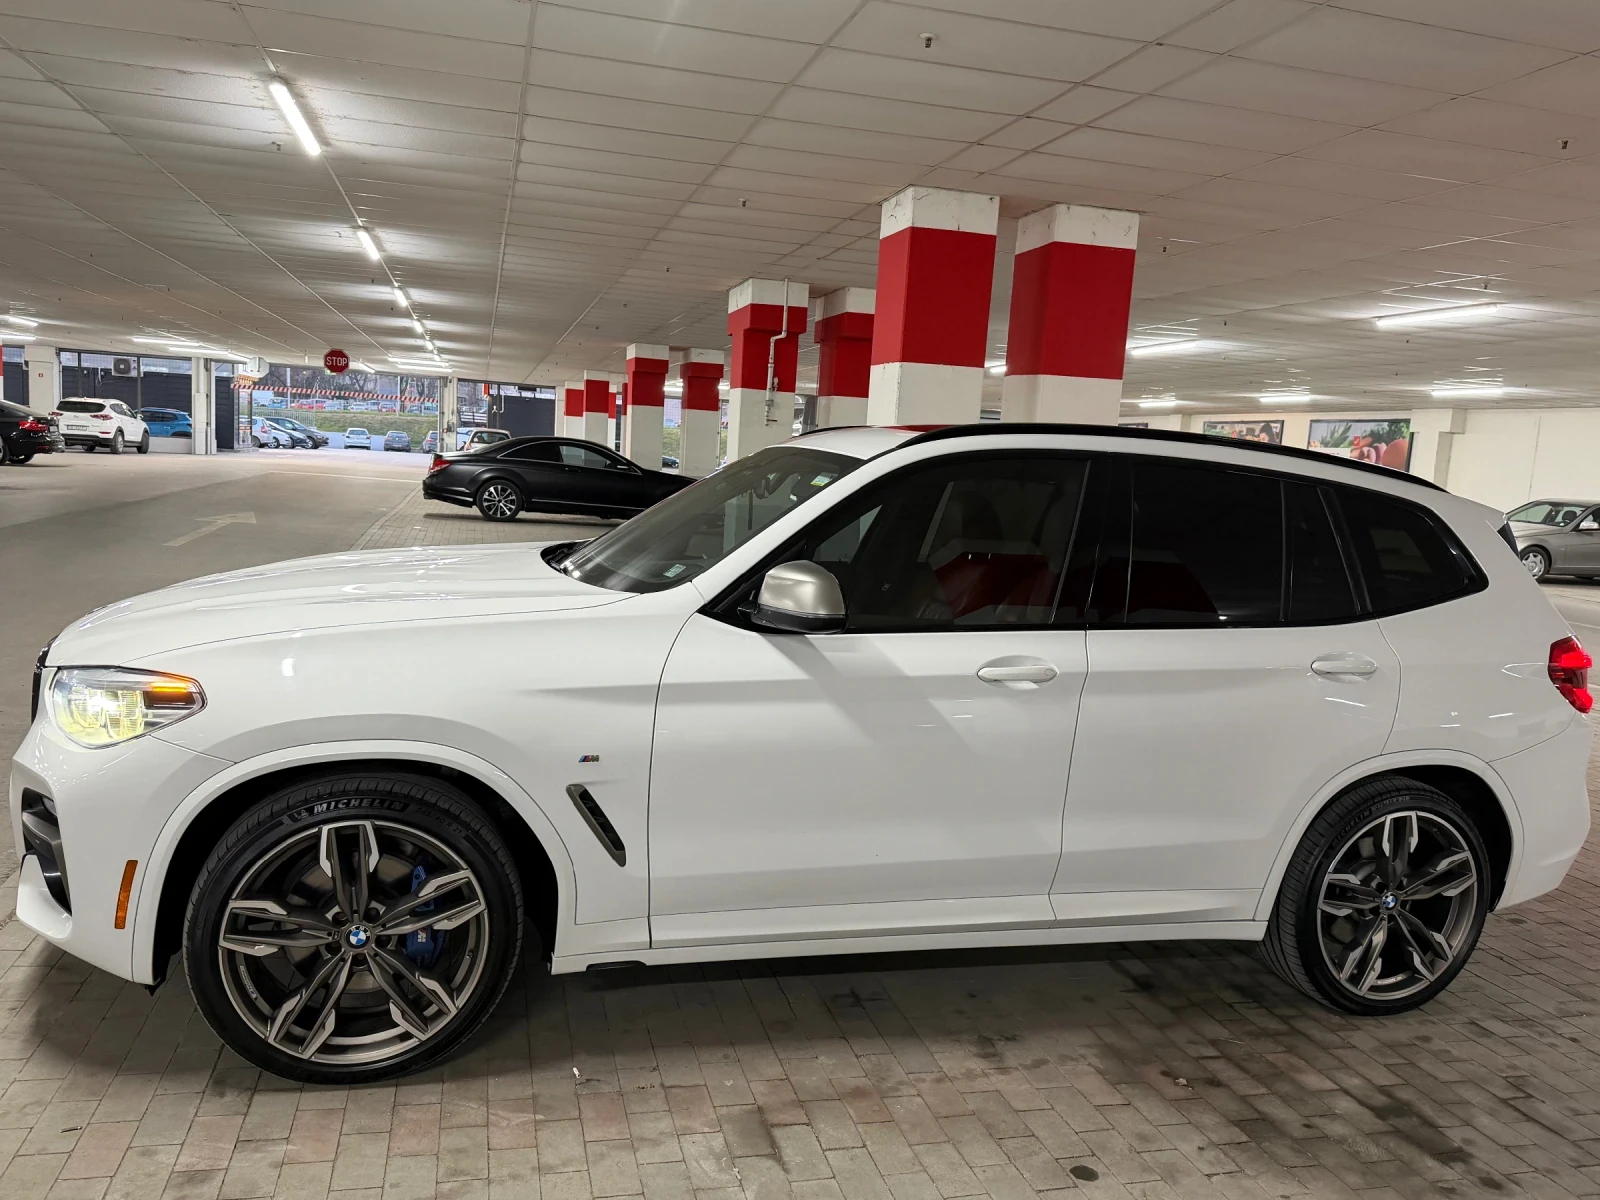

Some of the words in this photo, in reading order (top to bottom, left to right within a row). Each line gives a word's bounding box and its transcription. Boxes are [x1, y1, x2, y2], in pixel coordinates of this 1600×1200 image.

[326, 356, 348, 367] STOP
[313, 798, 405, 814] MICHELIN
[1331, 808, 1371, 848] MICHELIN
